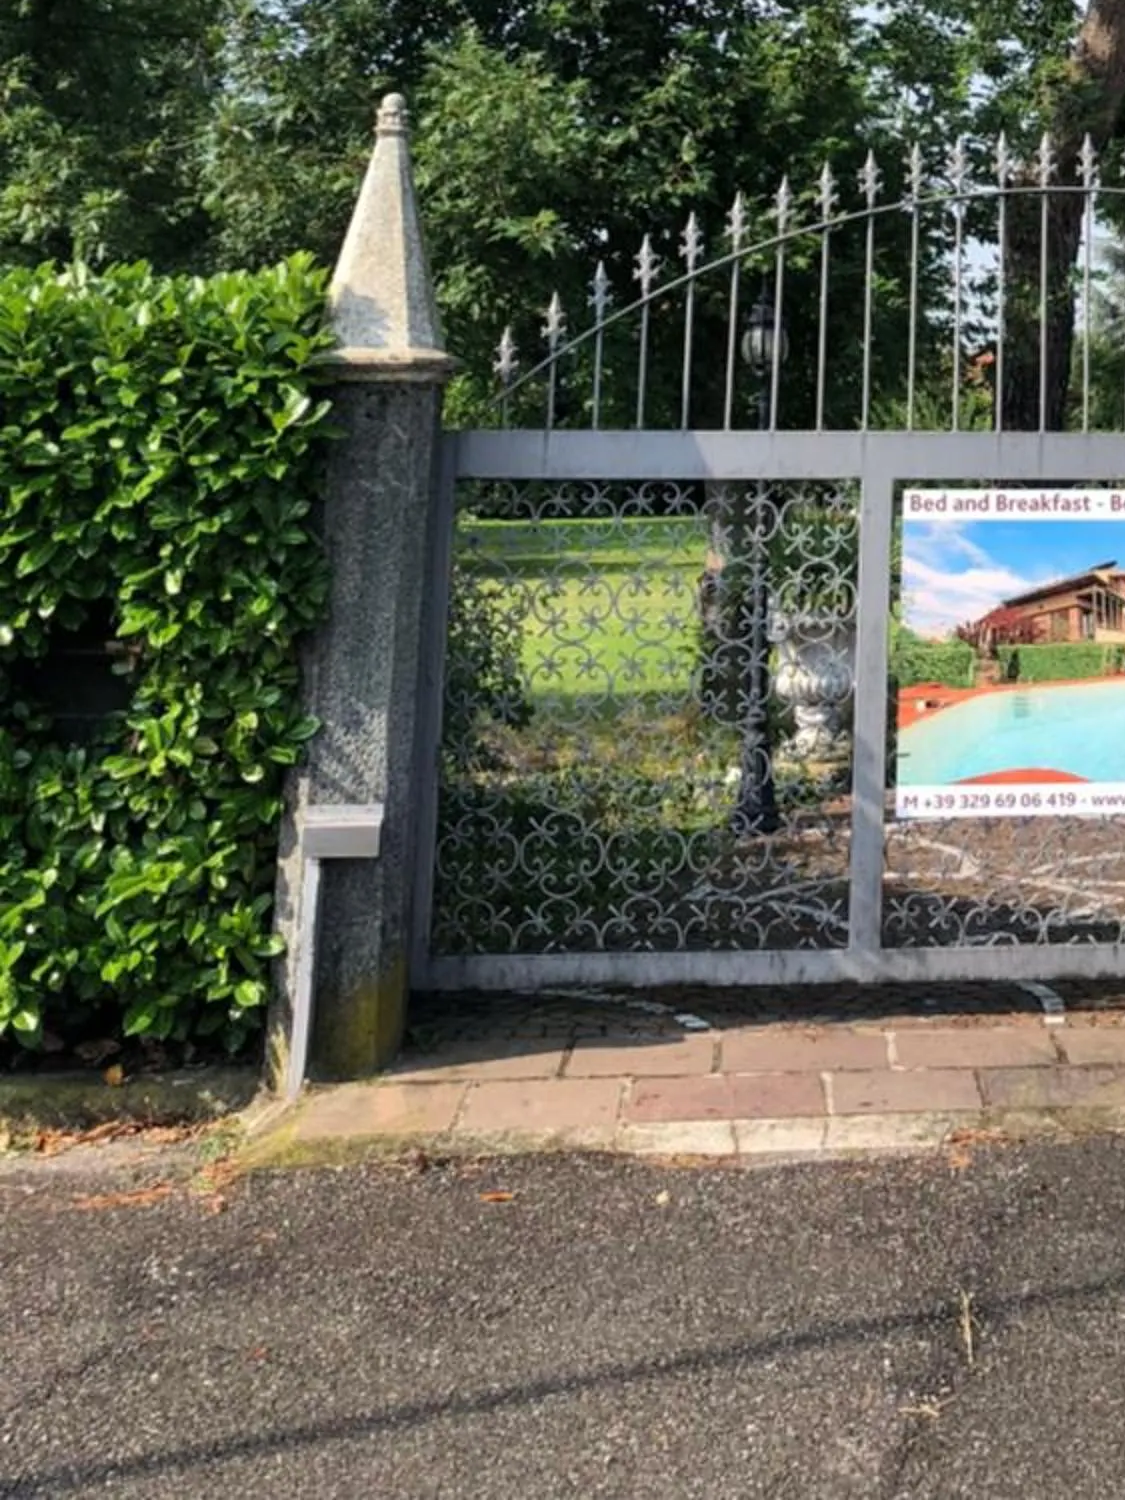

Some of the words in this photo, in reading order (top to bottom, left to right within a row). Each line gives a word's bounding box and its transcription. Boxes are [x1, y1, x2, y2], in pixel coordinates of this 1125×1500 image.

[910, 494, 947, 512] Bed
[953, 494, 990, 512] and
[996, 493, 1091, 512] Breakfast
[903, 795, 919, 809] M
[924, 794, 955, 809] +39
[959, 793, 991, 809] 329
[995, 793, 1017, 808] 69
[1020, 792, 1042, 808] 06
[1046, 792, 1077, 807] 419
